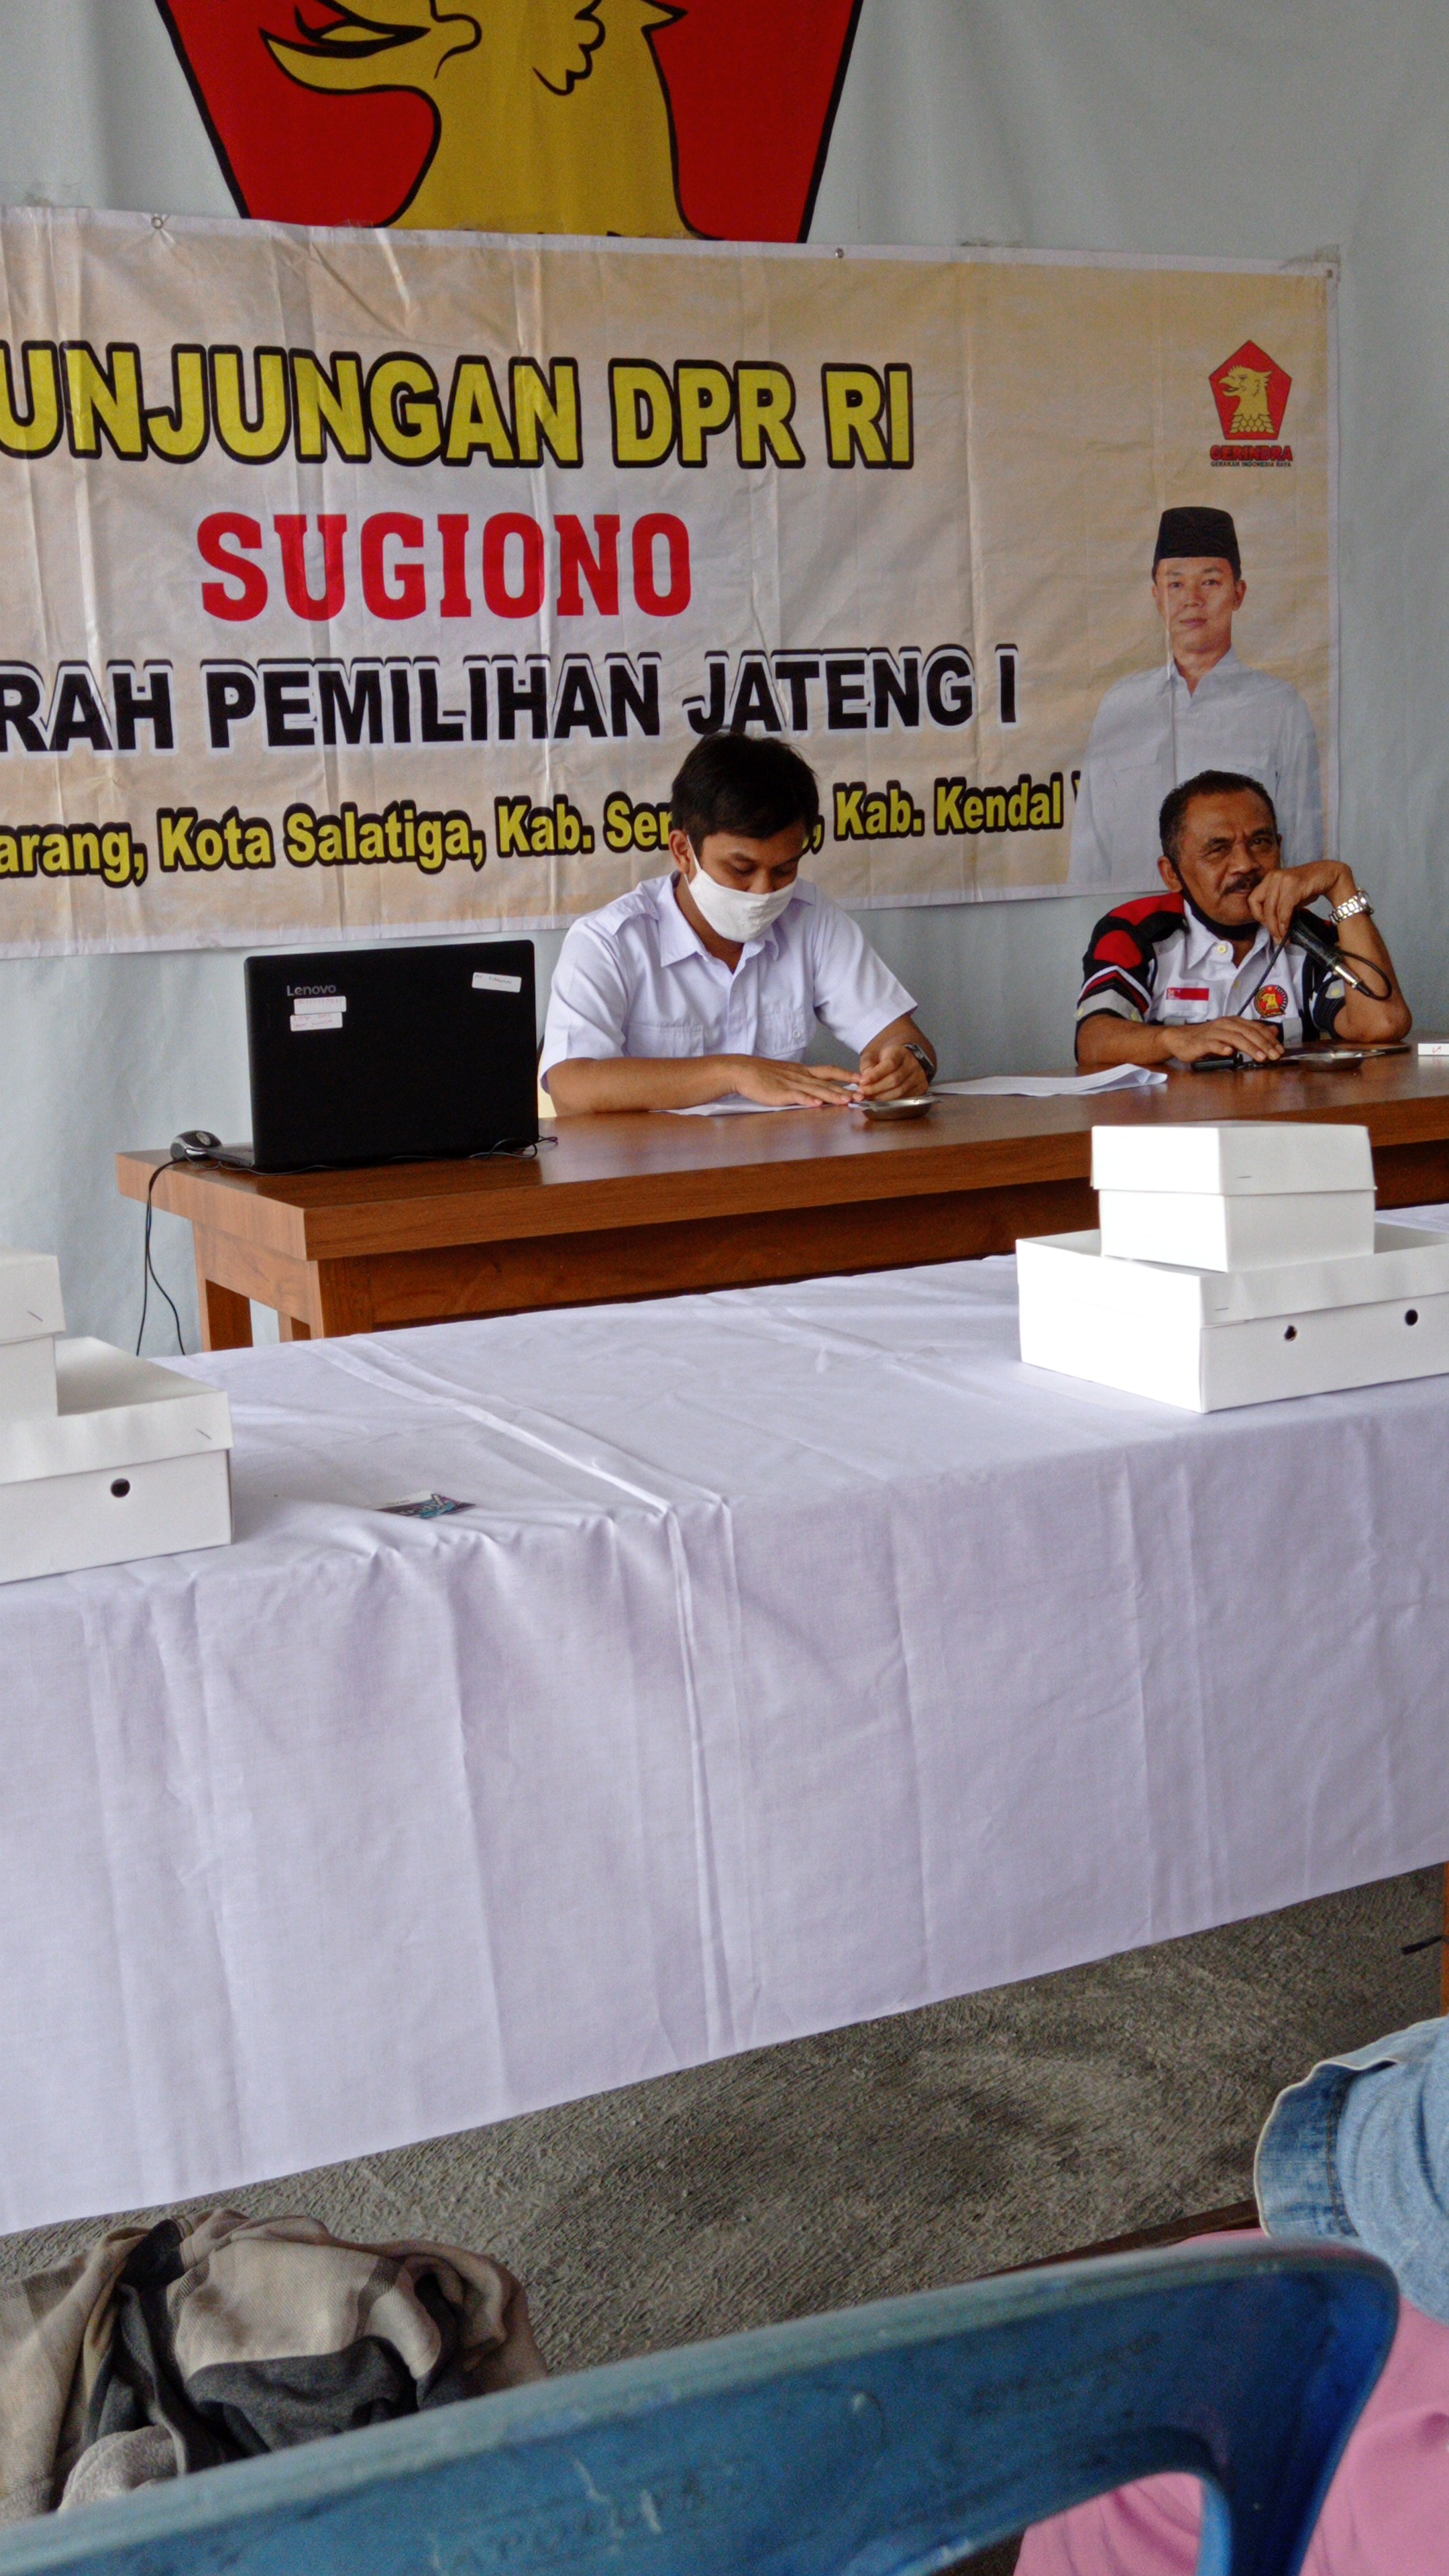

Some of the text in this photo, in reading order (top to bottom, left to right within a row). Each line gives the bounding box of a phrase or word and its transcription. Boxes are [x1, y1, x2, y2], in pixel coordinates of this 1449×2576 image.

[608, 358, 806, 469] DPR
[821, 363, 914, 470] RI
[1210, 445, 1293, 461] GERINDRA
[197, 512, 691, 621] SUGIONO
[200, 653, 661, 748] PEMILIHAN
[682, 644, 975, 735] JATENG
[995, 643, 1018, 724] I
[156, 806, 275, 872] Kota
[282, 800, 486, 874] Salatiga,
[494, 794, 594, 857] Kab.
[833, 780, 924, 841] Kab.
[934, 772, 1063, 835] Kendal
[286, 985, 337, 996] Lenovo
